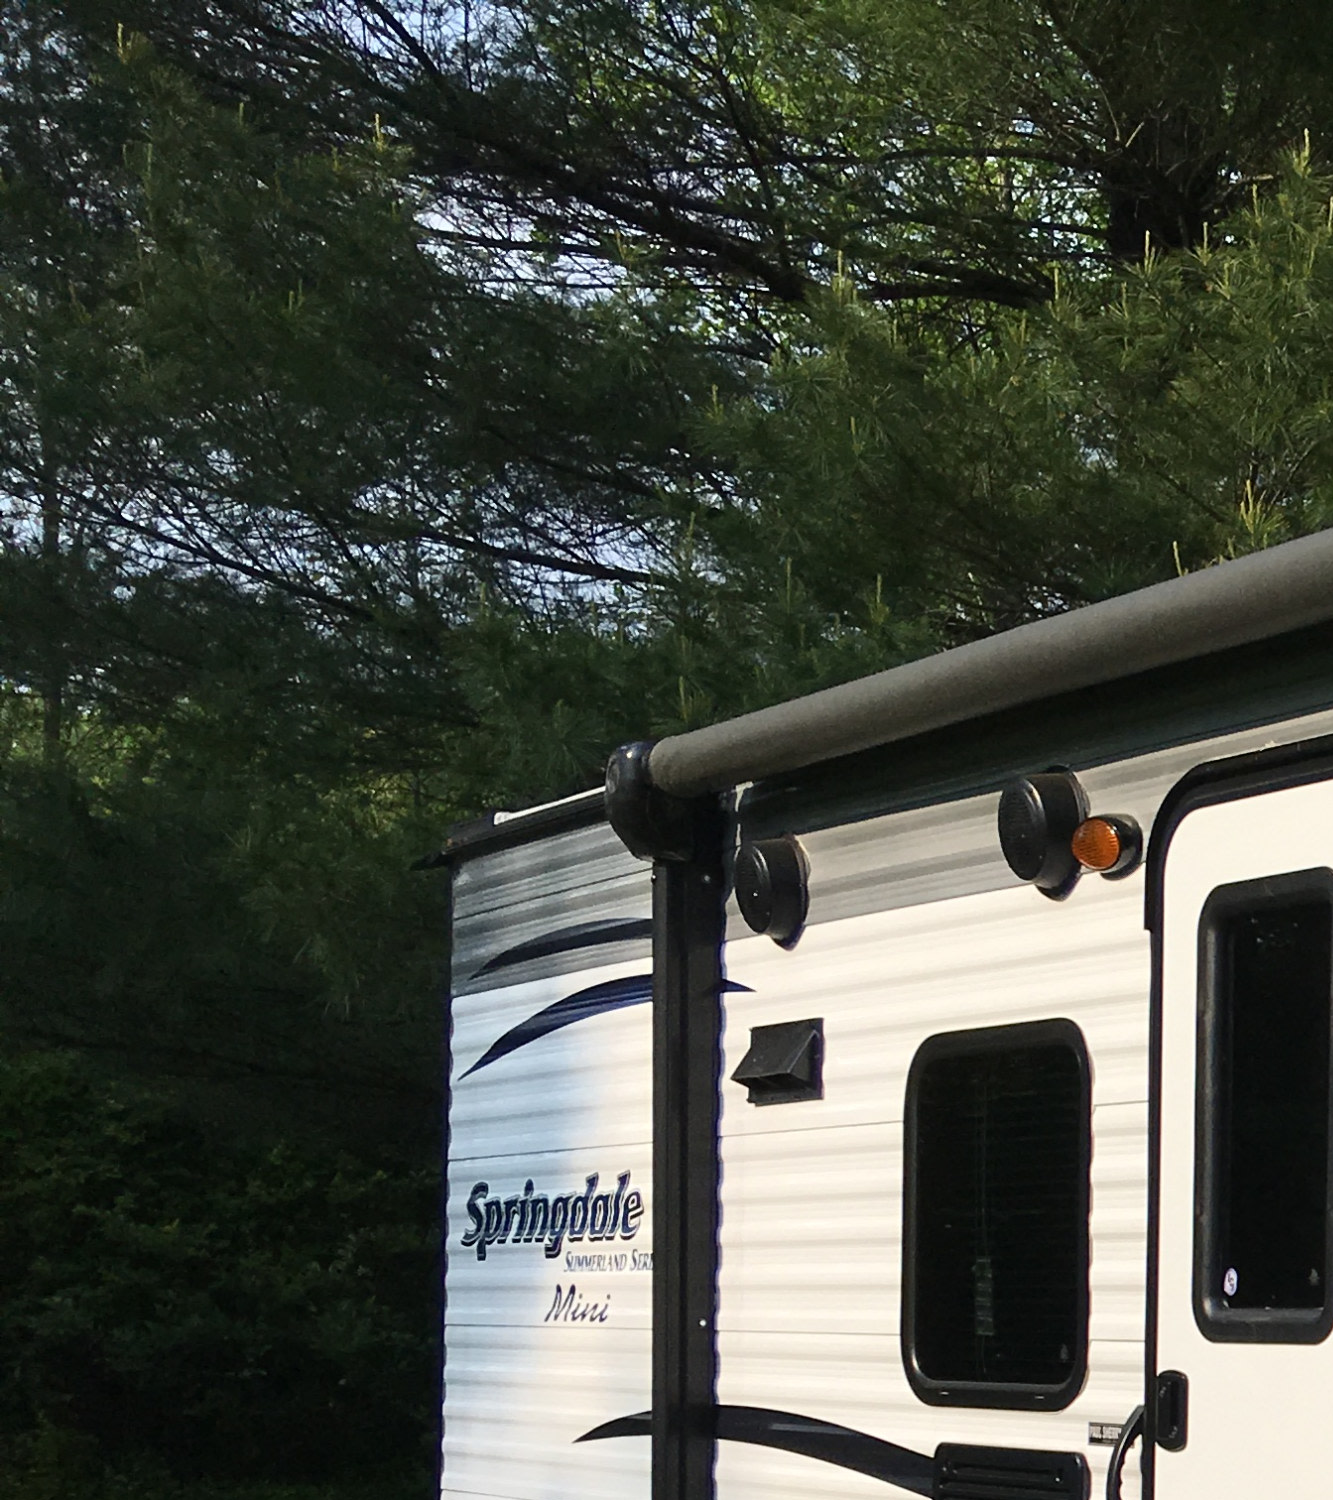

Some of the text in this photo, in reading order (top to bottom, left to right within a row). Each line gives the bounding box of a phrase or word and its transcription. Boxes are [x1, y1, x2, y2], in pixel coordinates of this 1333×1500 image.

[461, 1170, 645, 1261] Springdale
[563, 1251, 627, 1272] SUMMERLAND
[545, 1284, 612, 1323] Mini
